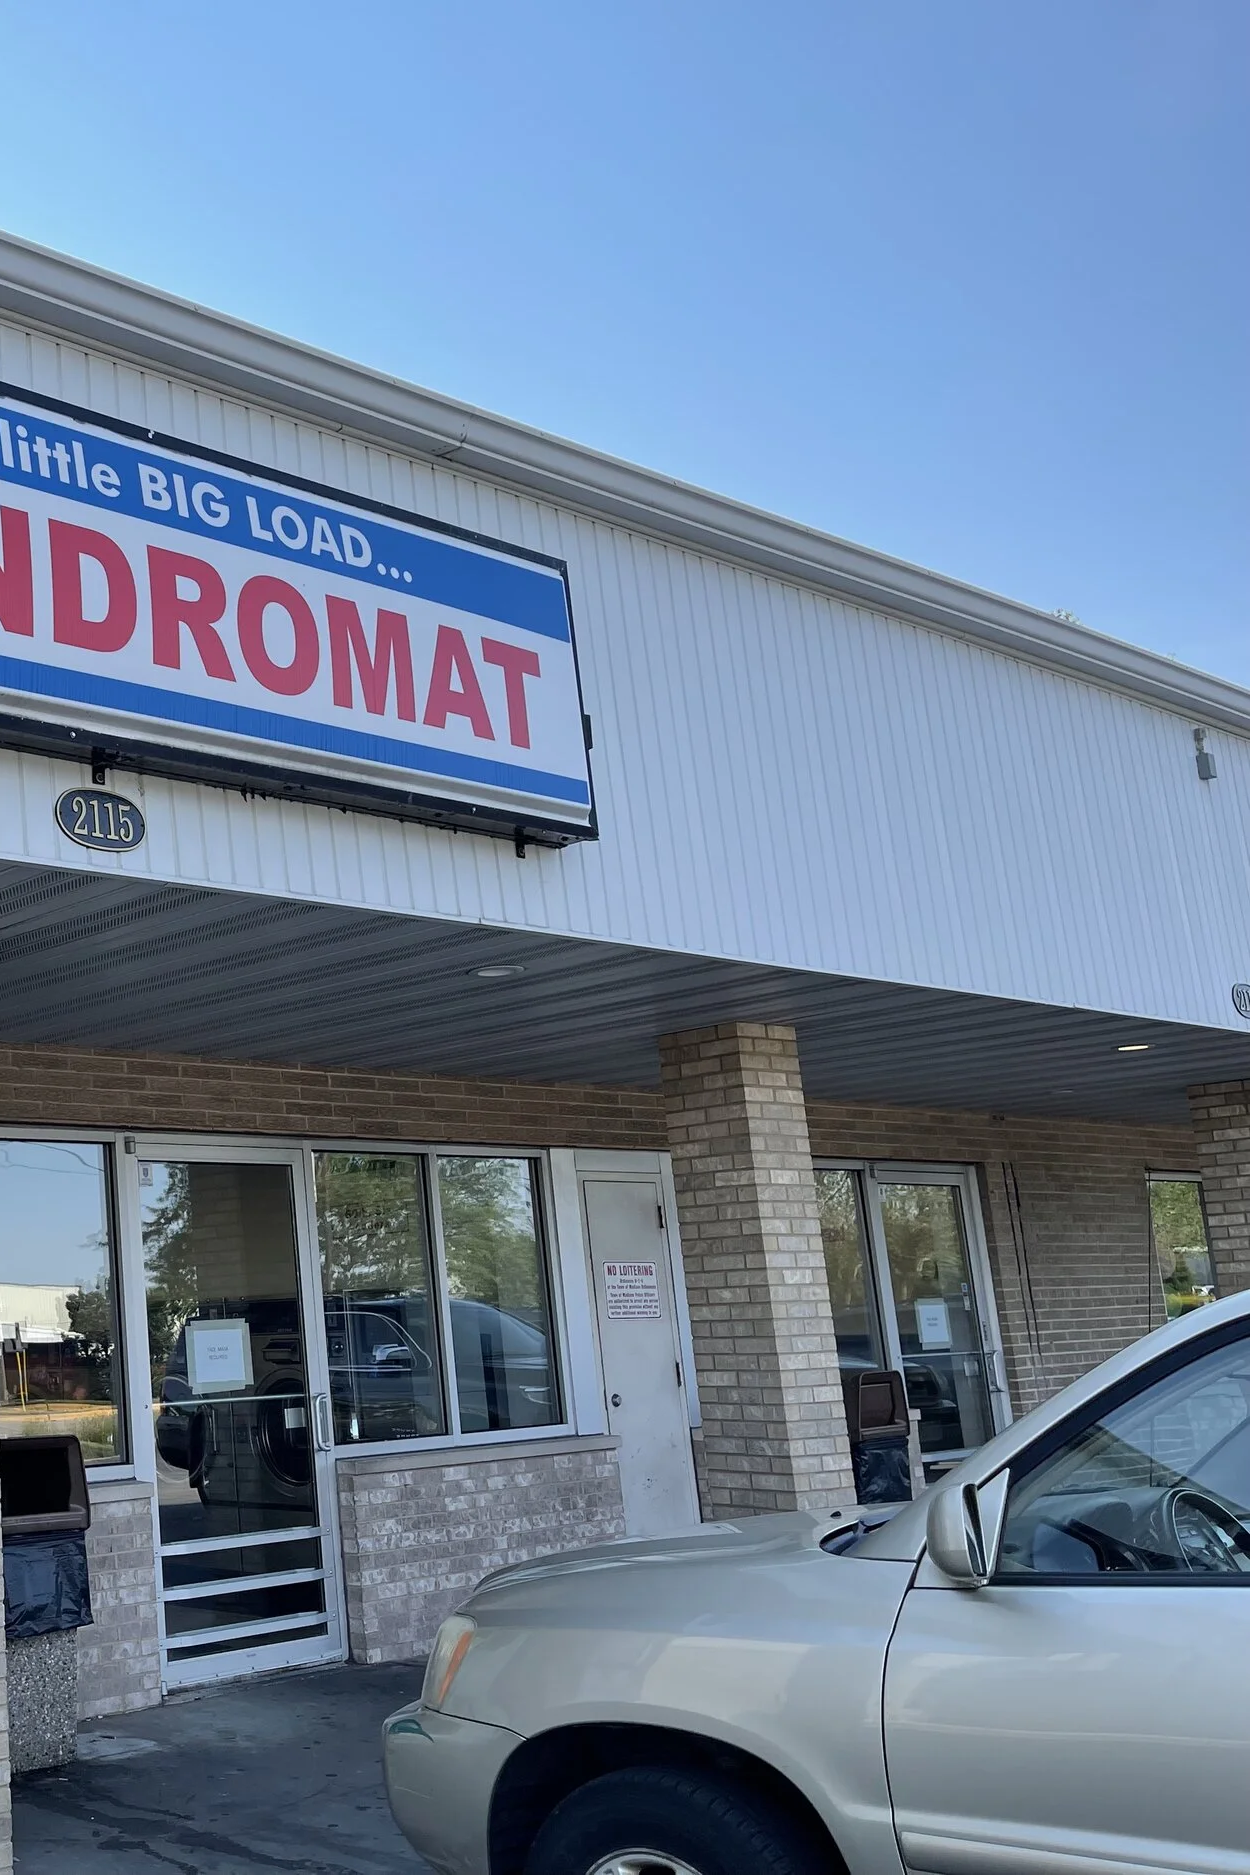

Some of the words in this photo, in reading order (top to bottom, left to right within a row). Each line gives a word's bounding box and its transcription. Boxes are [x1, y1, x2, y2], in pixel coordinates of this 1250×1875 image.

[138, 463, 231, 529] BIG
[72, 796, 134, 842] 2115
[607, 1265, 617, 1276] NO
[619, 1265, 653, 1276] LOITERING
